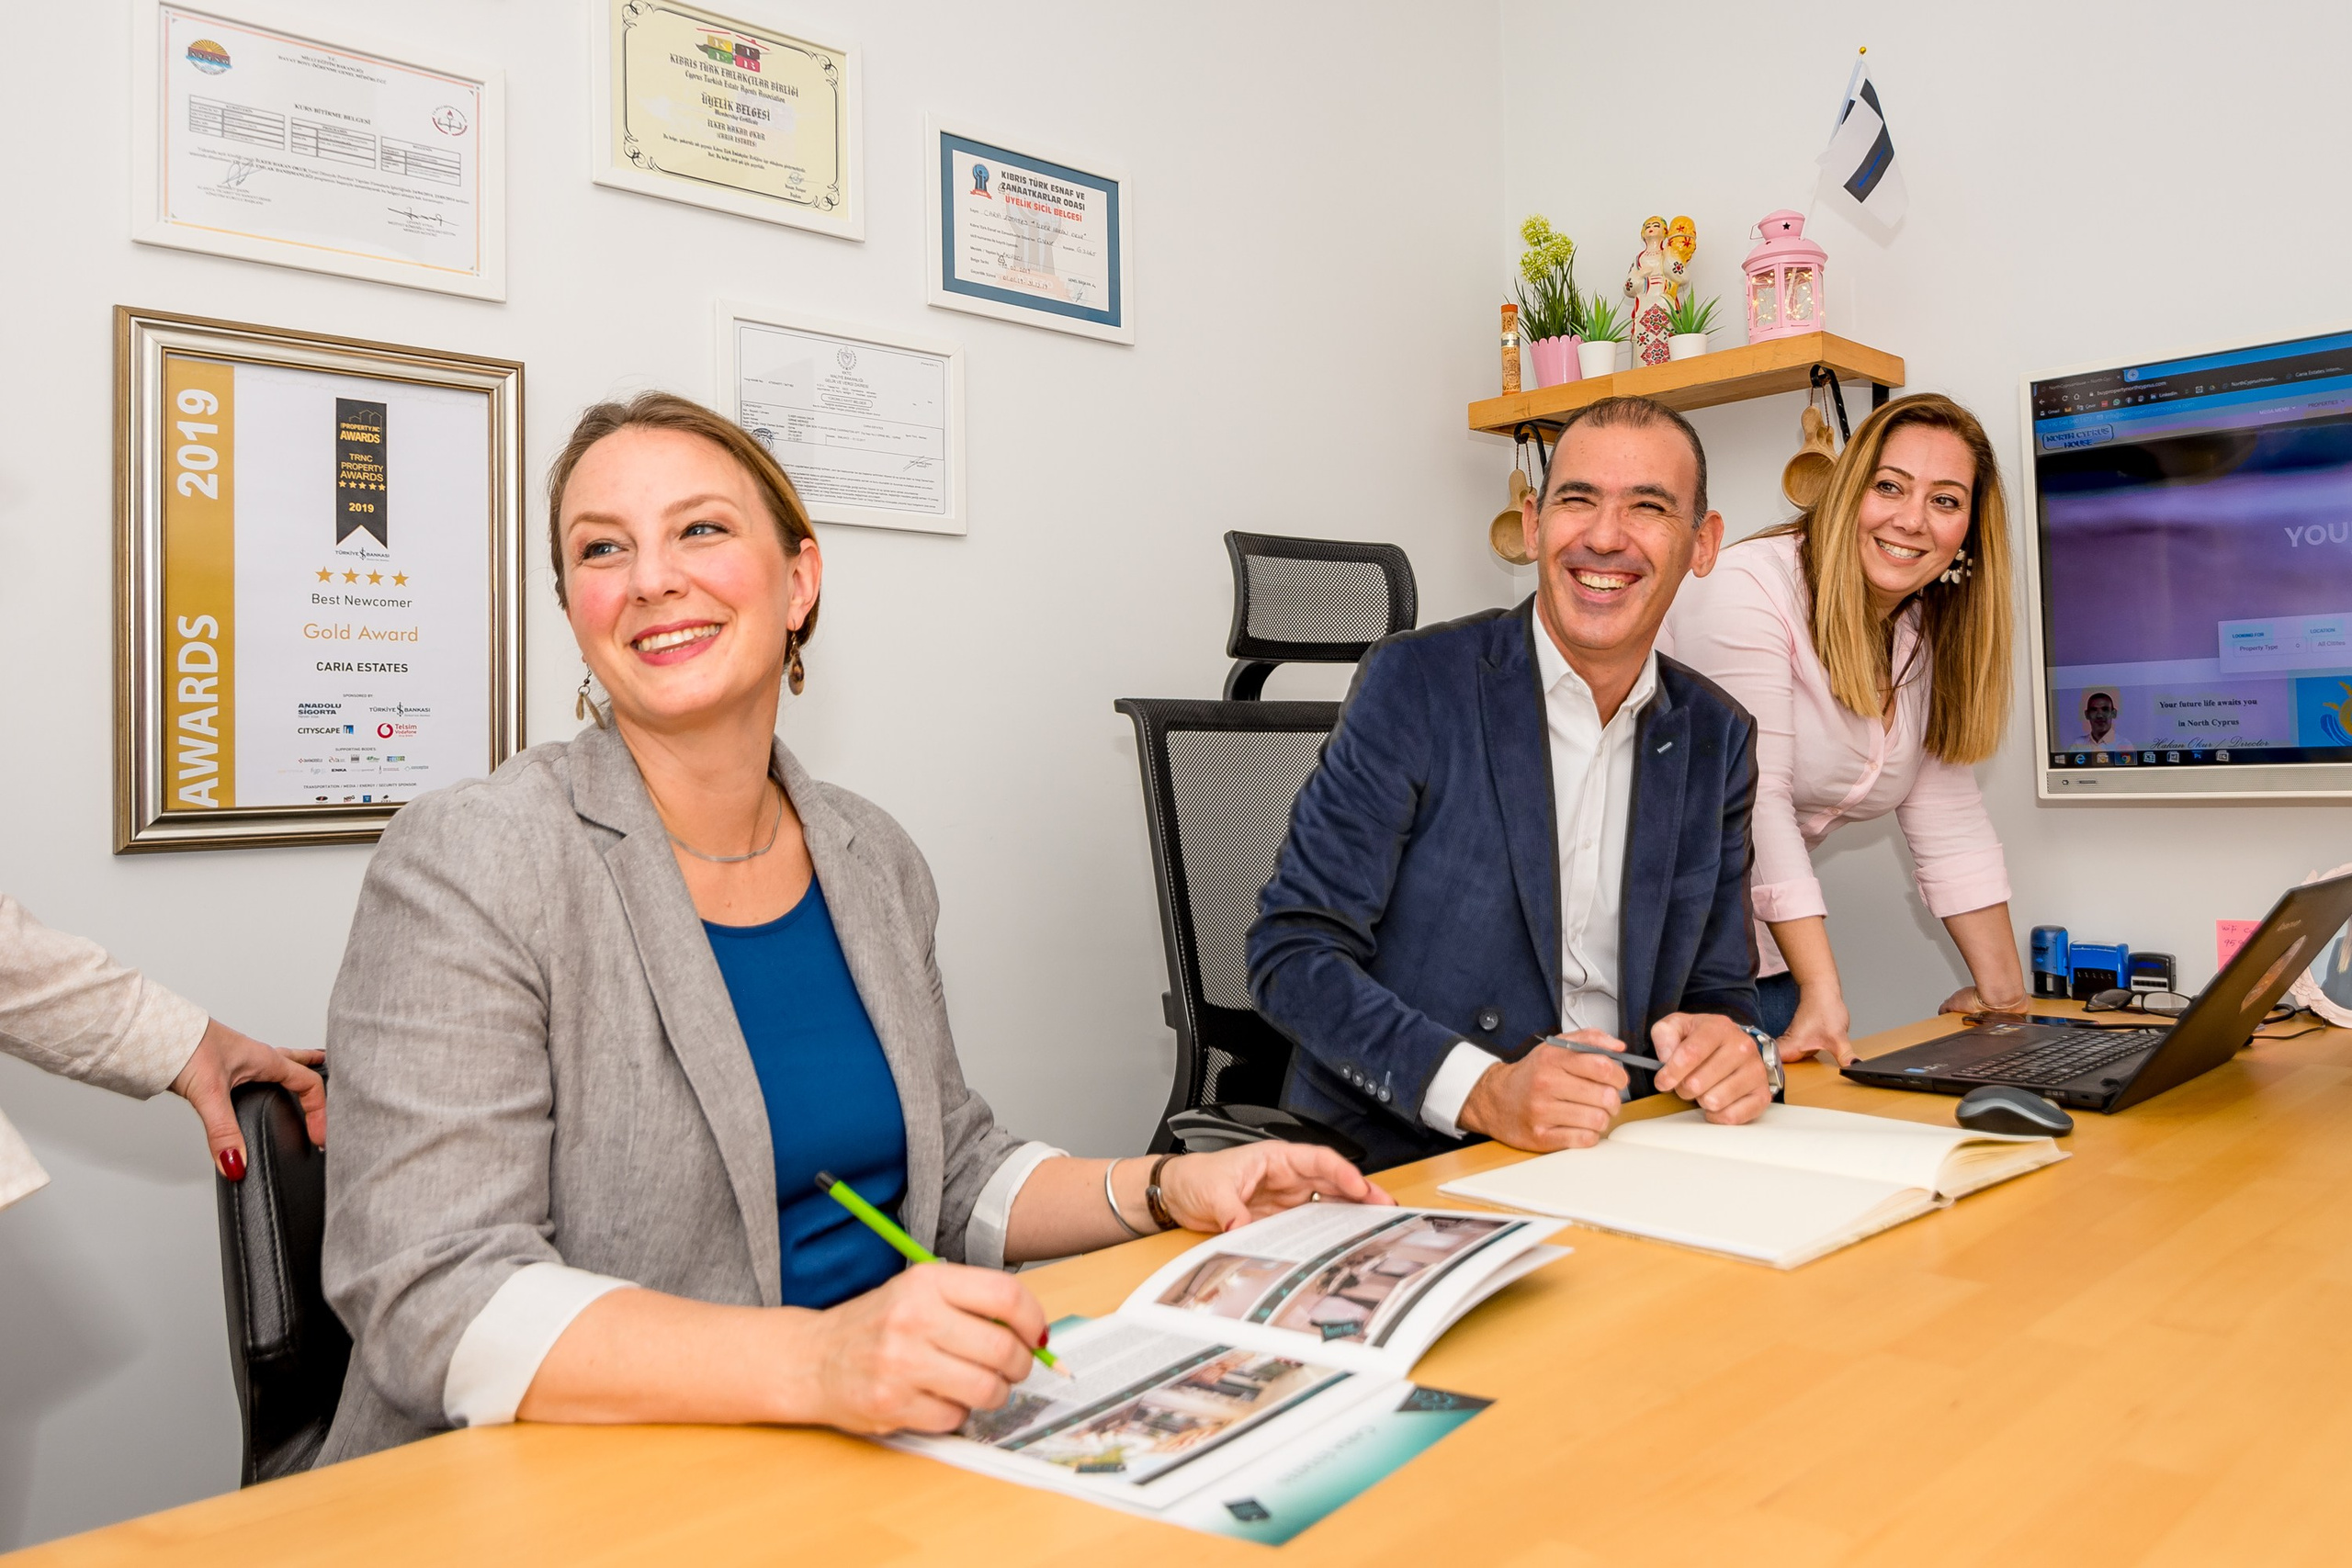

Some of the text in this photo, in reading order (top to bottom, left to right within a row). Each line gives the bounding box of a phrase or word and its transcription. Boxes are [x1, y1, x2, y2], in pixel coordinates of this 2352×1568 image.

[670, 53, 697, 69] KIBRIS
[1001, 171, 1085, 200] KIBRIS TÜRK ESNAF VE
[1001, 182, 1061, 204] ZANAATKARLAR
[1063, 198, 1085, 211] ODASI
[1005, 194, 1082, 221] ÜYELİK SİCİL BELGESİ
[340, 431, 380, 444] AWARDS
[2046, 427, 2109, 443] NORTH CYPRUS
[176, 389, 219, 500] 2019
[2064, 438, 2092, 449] HOUSE
[349, 453, 373, 463] TRNC
[341, 461, 383, 473] PROPERTY
[340, 470, 383, 482] AWARDS
[348, 502, 375, 513] 2019
[2284, 522, 2352, 547] YOU
[311, 593, 413, 608] Best Newcomer
[303, 623, 418, 642] Gold Award
[316, 661, 409, 673] CARIA ESTATES
[2179, 700, 2201, 708] future
[2217, 698, 2241, 706] awaits
[2243, 699, 2257, 707] you
[177, 615, 219, 808] AWARDS
[2188, 718, 2210, 727] North
[2211, 718, 2239, 728] Cyprus
[2150, 738, 2186, 750] Hakan
[2187, 736, 2212, 749] Okur
[2227, 735, 2269, 748] Director
